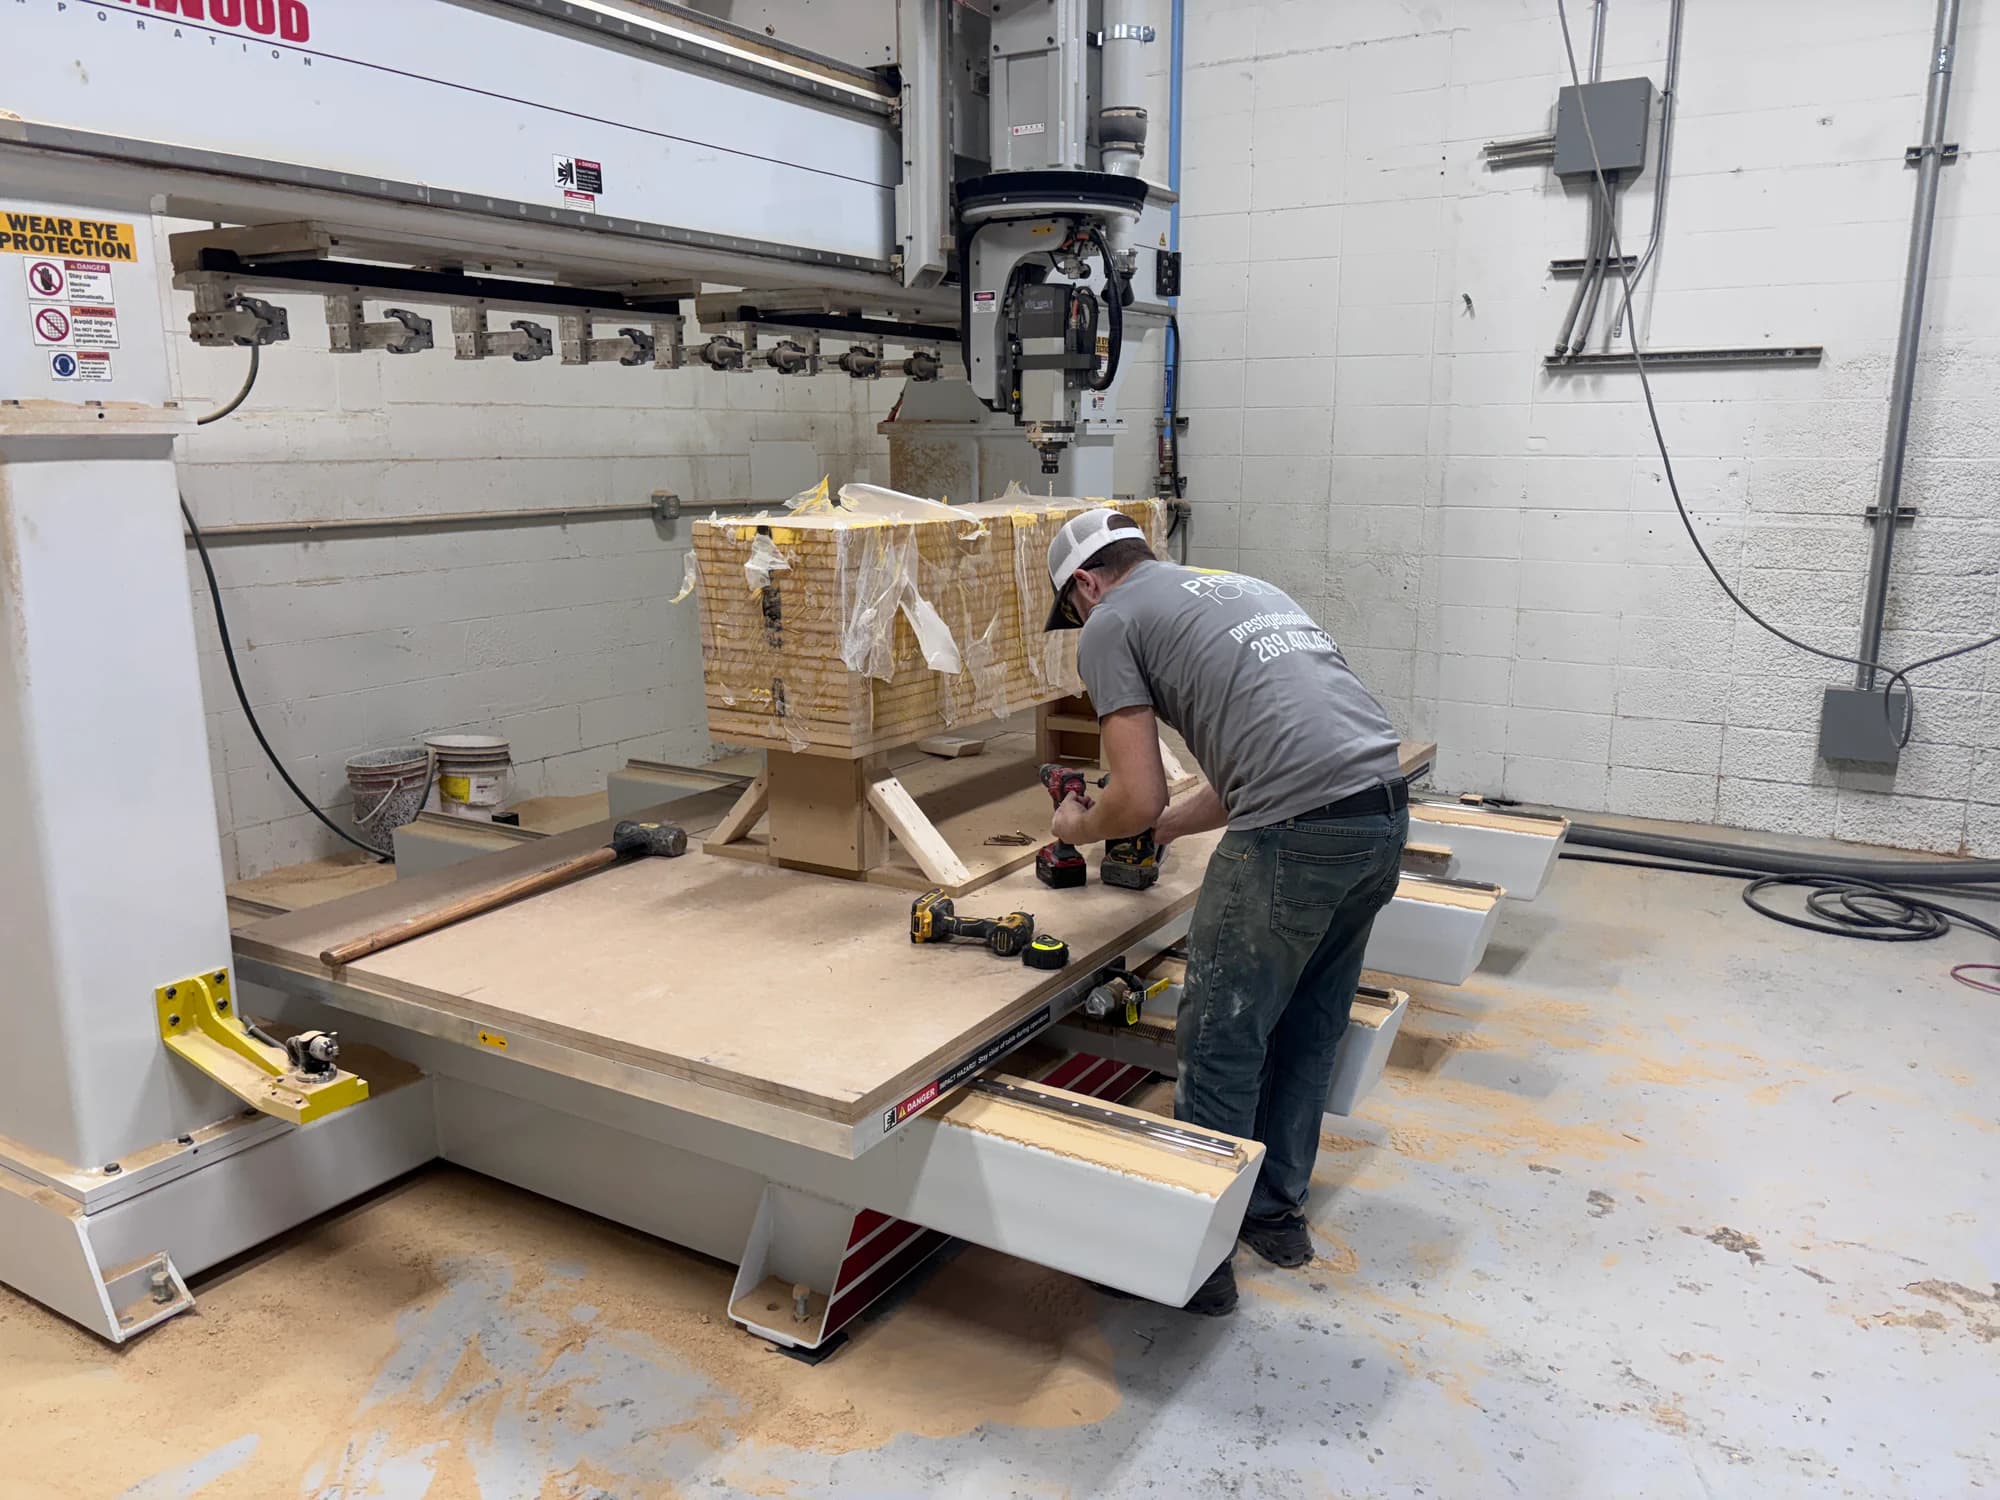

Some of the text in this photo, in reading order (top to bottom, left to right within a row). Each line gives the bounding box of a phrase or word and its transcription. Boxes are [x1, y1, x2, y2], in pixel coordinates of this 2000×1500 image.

[6, 213, 119, 241] WEAR EYE
[0, 231, 131, 259] PROTECTION
[76, 263, 106, 271] DANGER
[906, 1087, 936, 1113] DANGER
[939, 1073, 957, 1090] IMPACT
[978, 1054, 989, 1064] Stay
